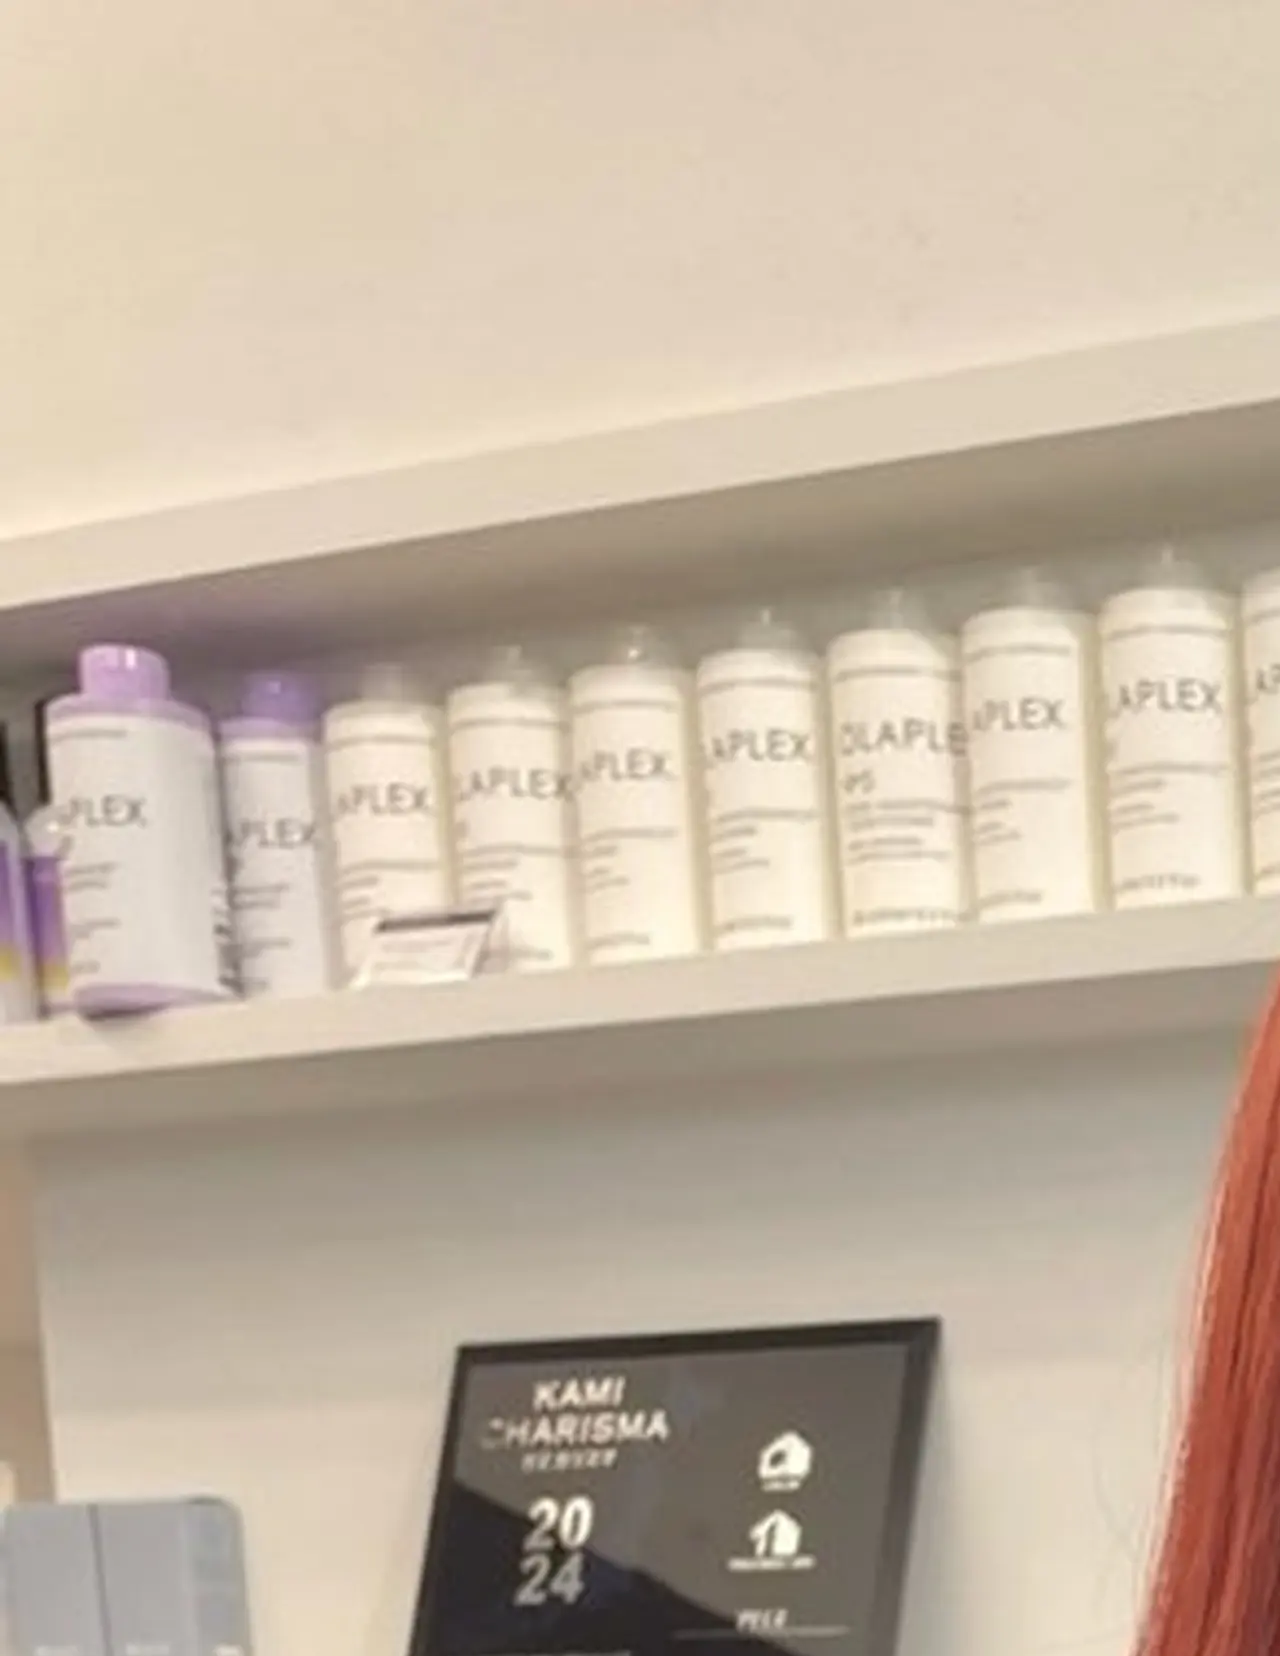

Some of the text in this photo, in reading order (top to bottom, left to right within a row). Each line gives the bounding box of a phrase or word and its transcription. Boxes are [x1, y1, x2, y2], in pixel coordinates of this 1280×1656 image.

[533, 1376, 627, 1412] KAMI
[523, 1495, 595, 1550] 20
[513, 1551, 585, 1608] 24
